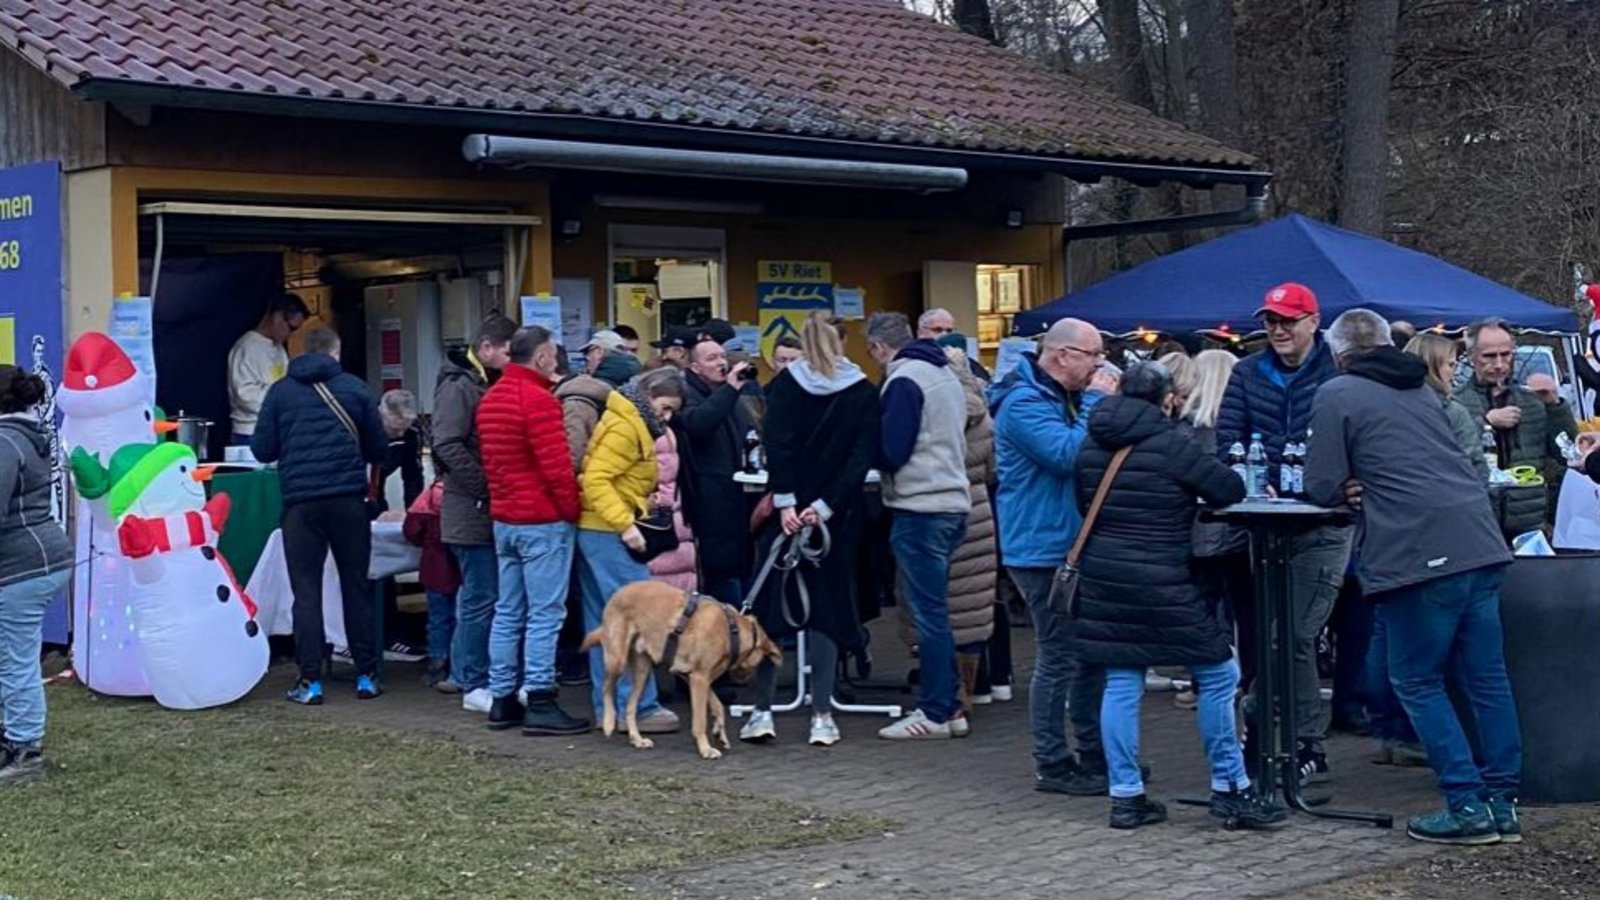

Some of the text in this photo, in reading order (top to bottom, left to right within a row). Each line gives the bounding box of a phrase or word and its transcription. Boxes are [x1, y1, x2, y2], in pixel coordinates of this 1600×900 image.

[0, 194, 33, 220] men
[0, 239, 20, 269] 68
[768, 263, 822, 279] SV Riet
